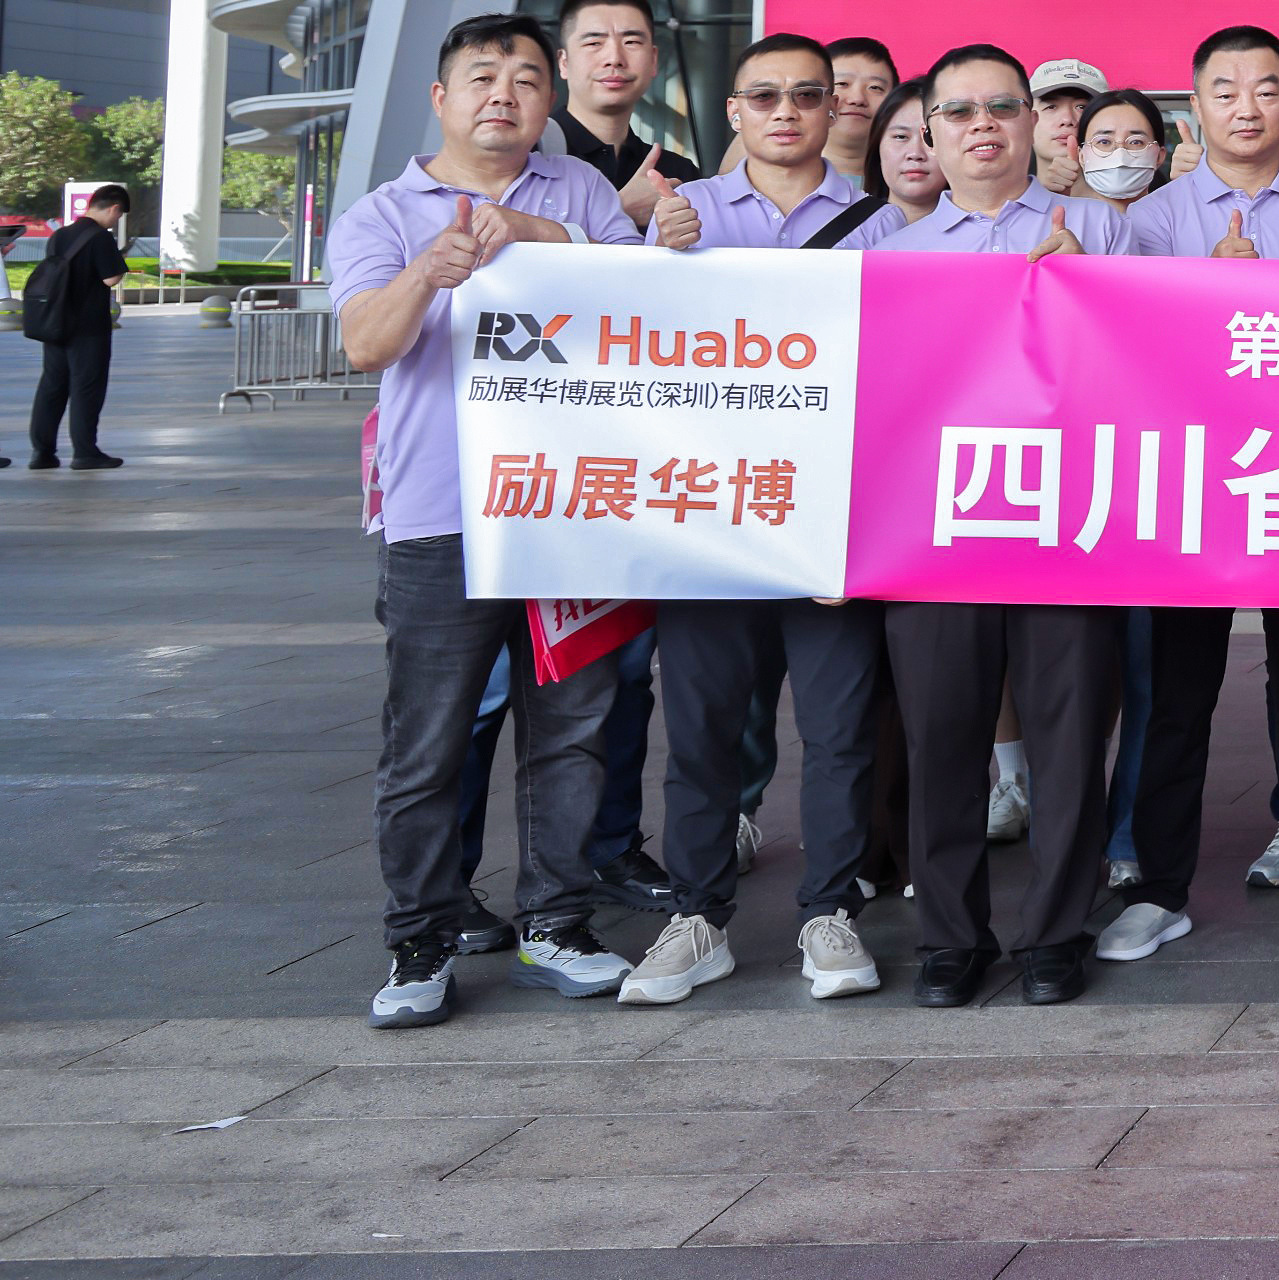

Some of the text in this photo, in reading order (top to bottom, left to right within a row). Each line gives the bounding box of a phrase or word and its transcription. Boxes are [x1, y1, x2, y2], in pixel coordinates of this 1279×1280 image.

[473, 311, 817, 370] RX Huabo
[468, 375, 829, 412] 励展华博展览(深圳)有限公司
[482, 452, 797, 527] 励展华博
